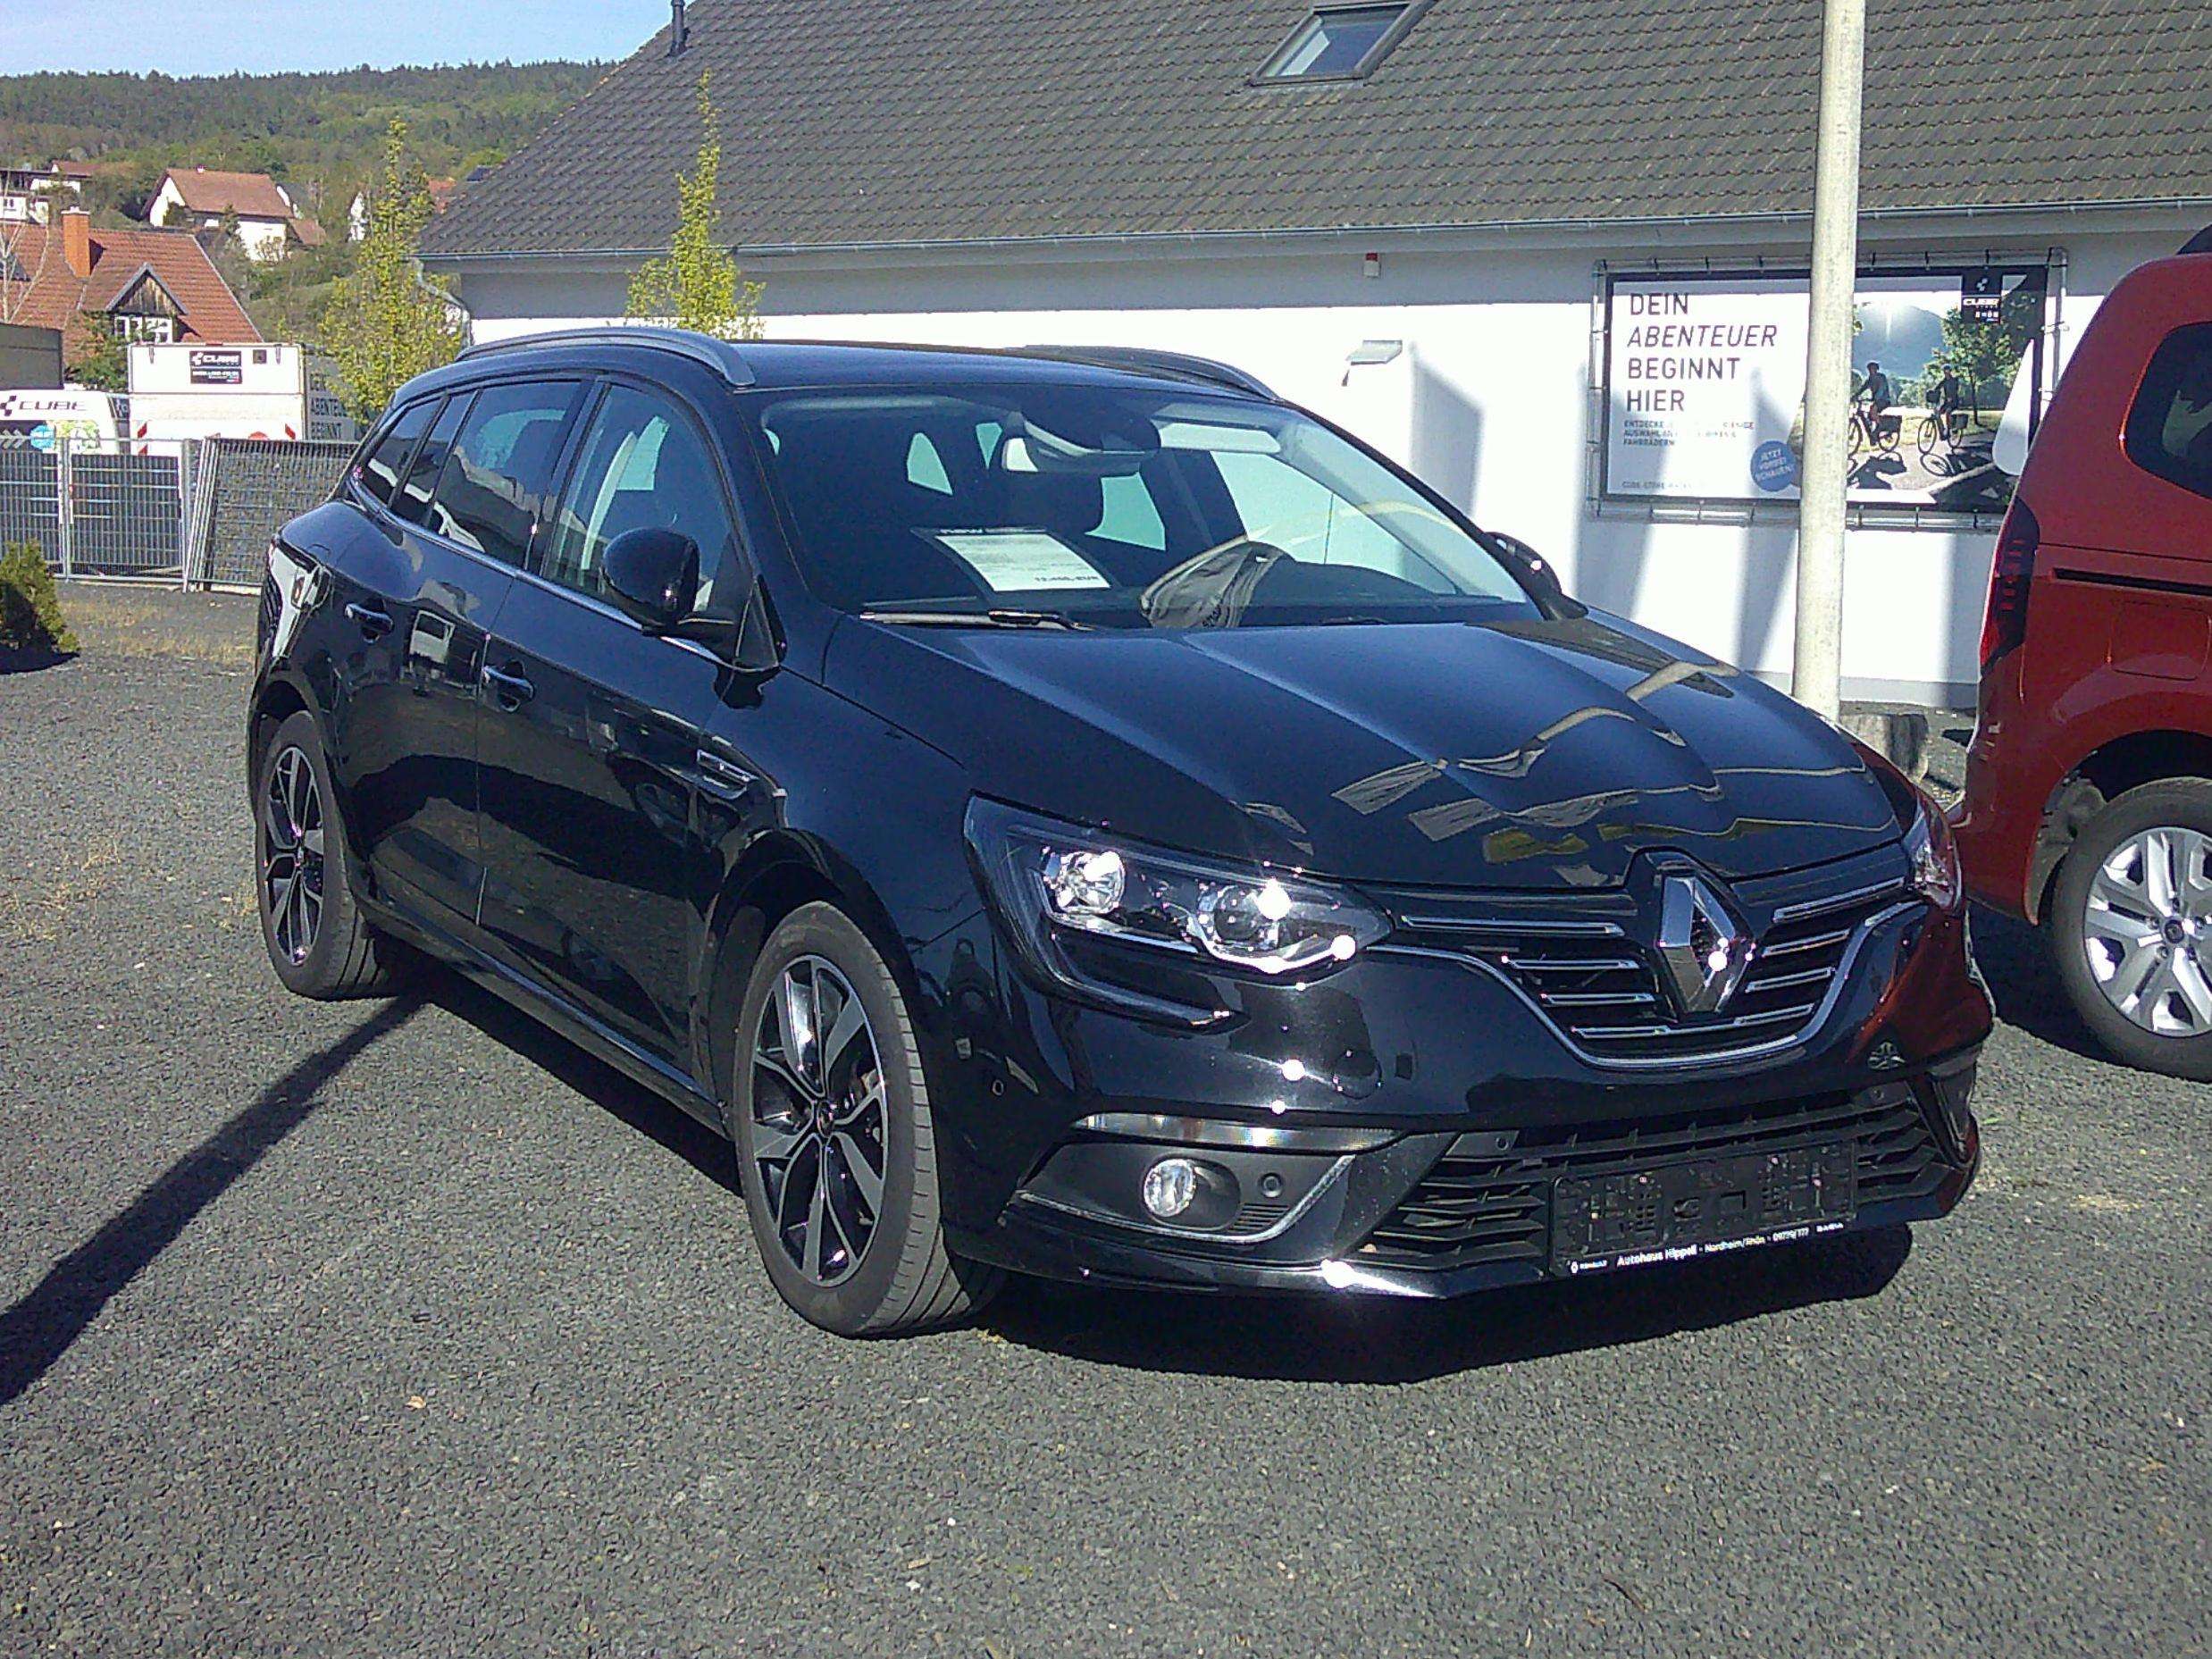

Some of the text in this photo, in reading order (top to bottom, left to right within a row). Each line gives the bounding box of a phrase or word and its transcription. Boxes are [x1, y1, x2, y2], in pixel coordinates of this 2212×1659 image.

[1630, 292, 1689, 315] DEIN
[1627, 325, 1778, 348] ABENTEUER
[1628, 357, 1741, 380] BEGINNT
[19, 401, 88, 410] CUBE
[1626, 390, 1686, 412] HIER
[1617, 1252, 1663, 1267] Autohaus
